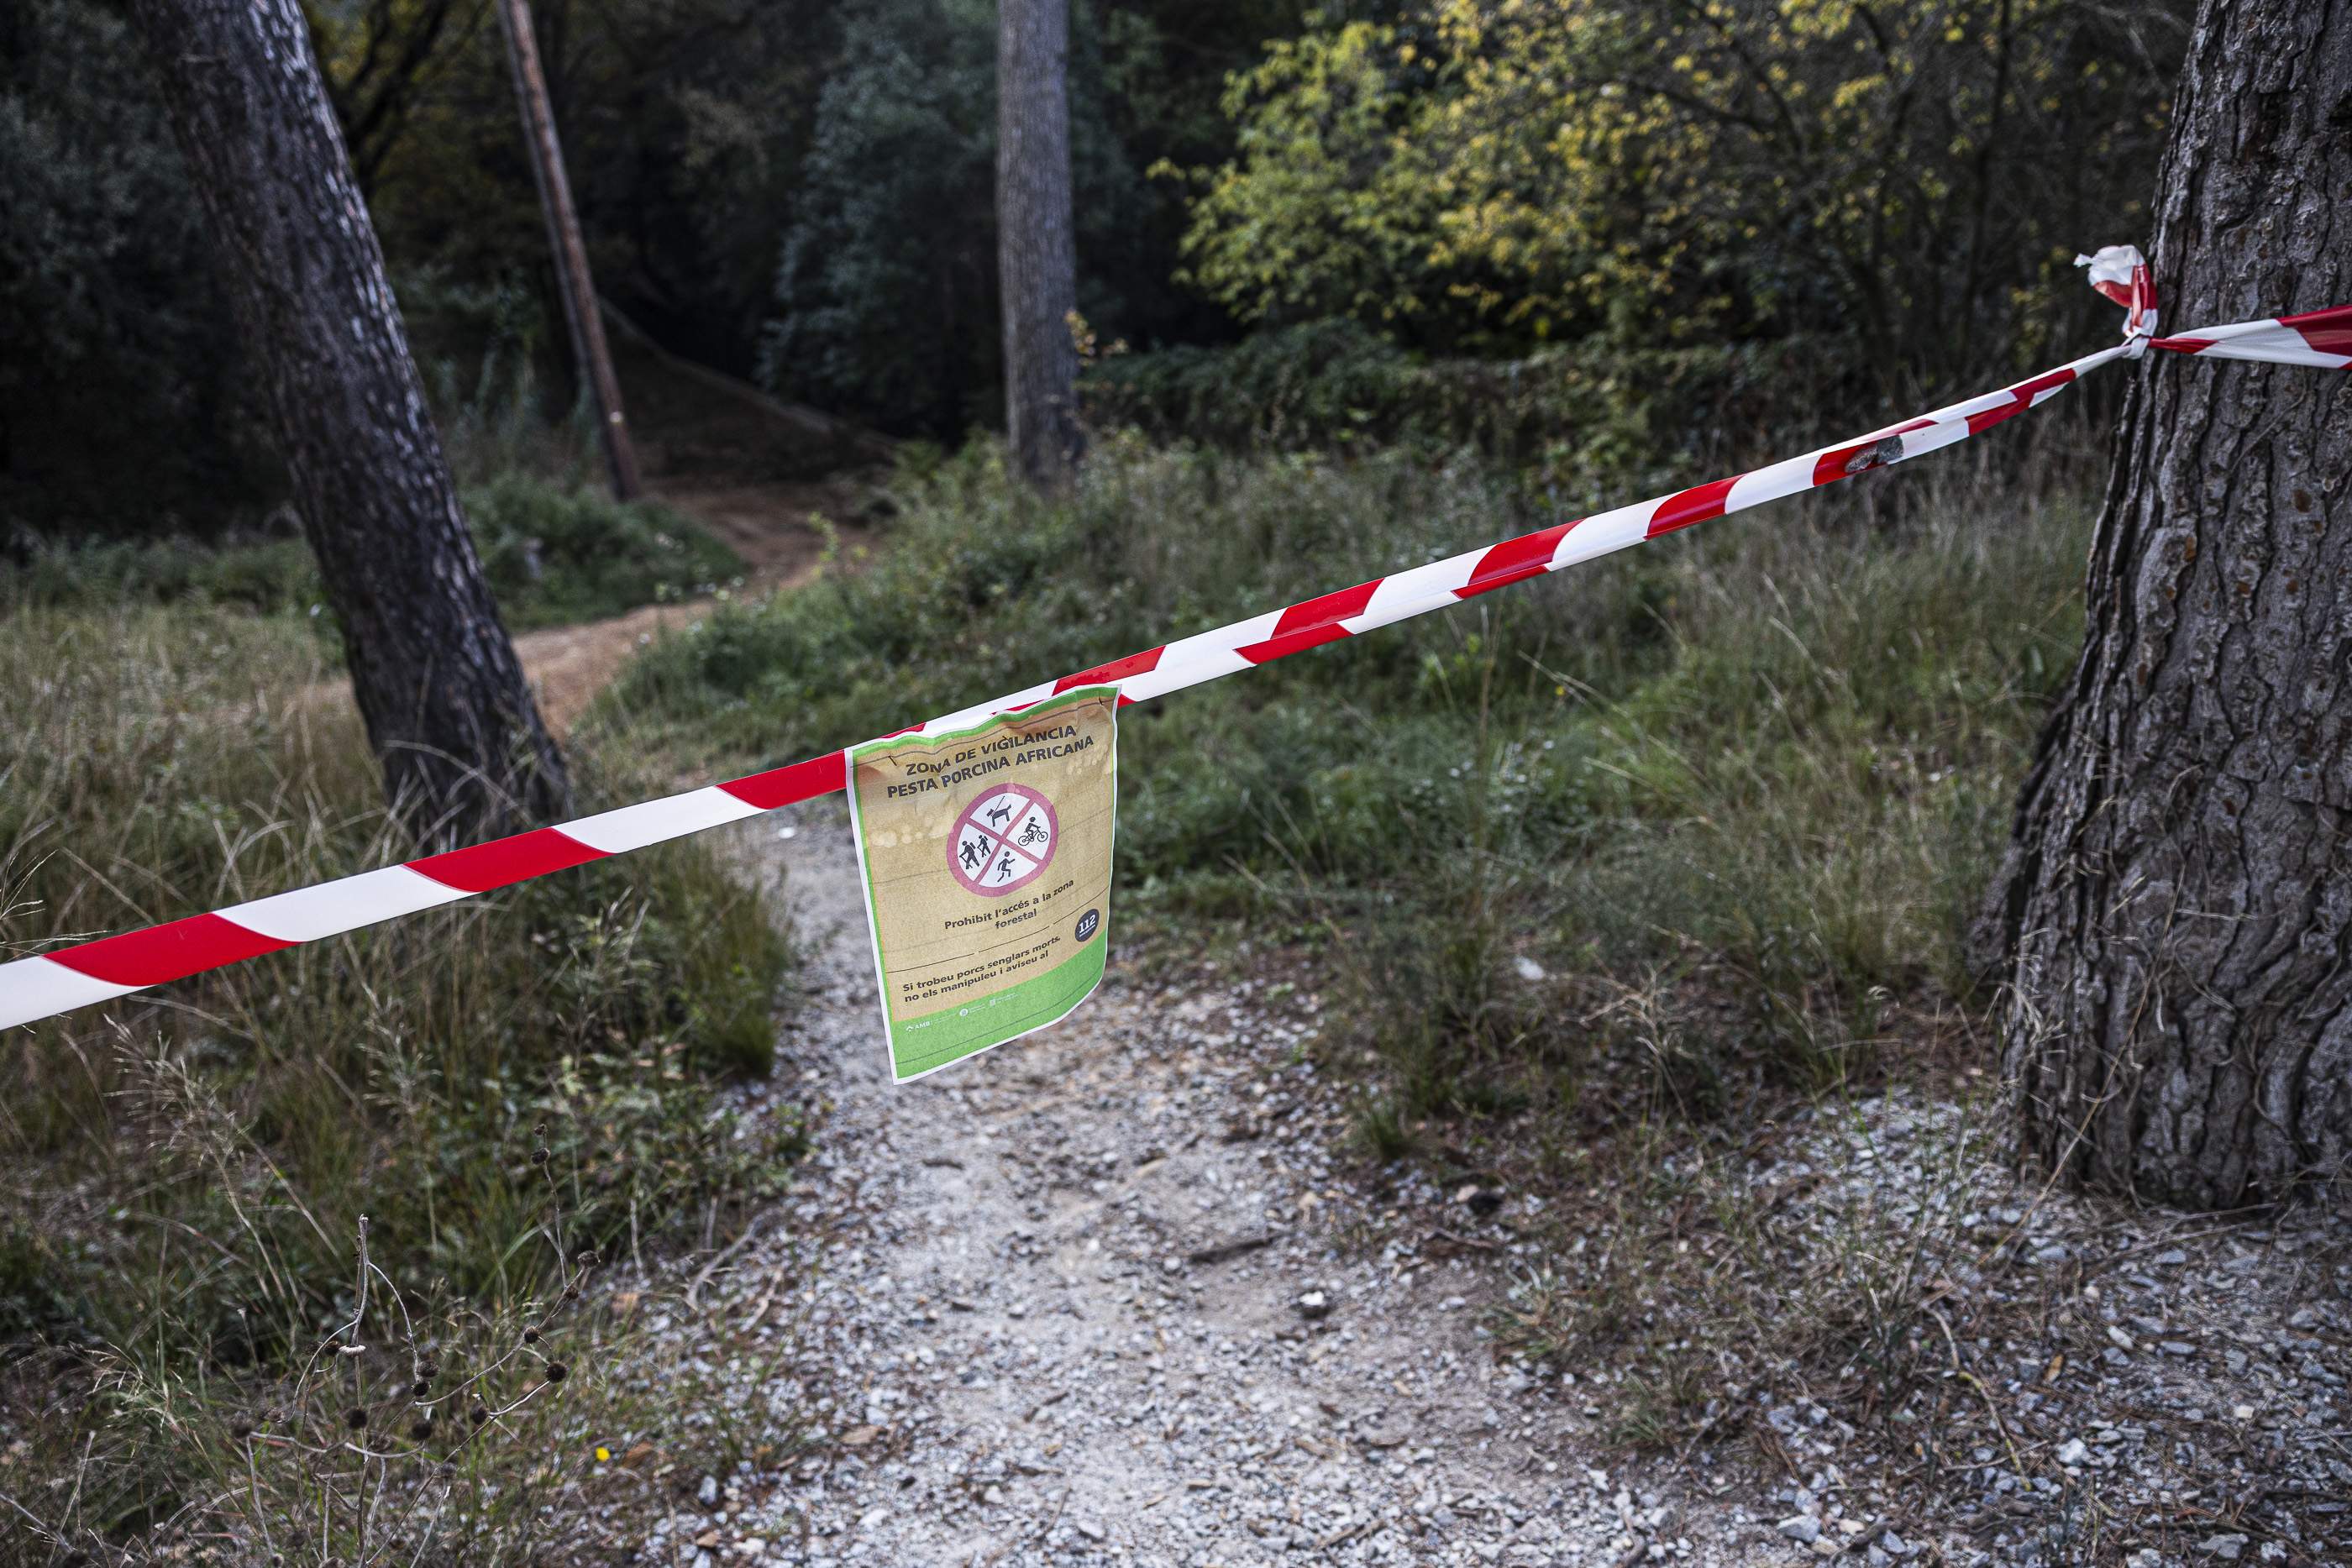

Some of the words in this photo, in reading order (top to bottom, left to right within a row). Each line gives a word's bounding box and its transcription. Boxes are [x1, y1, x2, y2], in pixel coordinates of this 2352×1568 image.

[887, 778, 938, 798] PESTA
[941, 758, 1010, 788] PORCINA
[1016, 735, 1094, 766] AFRICANA
[906, 758, 950, 776] ZONA
[955, 749, 977, 764] DE
[981, 725, 1077, 754] VIGILANCIA
[944, 913, 993, 930] Prohibit
[1032, 896, 1040, 905] a
[1042, 893, 1052, 902] la
[1053, 879, 1074, 896] zona
[995, 909, 1037, 930] forestal
[1079, 914, 1096, 934] 112
[903, 983, 914, 992] Si
[916, 973, 954, 989] trobeu
[957, 966, 985, 982] porcs
[987, 951, 1030, 969] senglars
[905, 994, 920, 1003] no
[922, 989, 938, 999] els
[941, 971, 997, 993] manipuleu
[1005, 957, 1037, 973] aviseu
[1040, 950, 1049, 959] al
